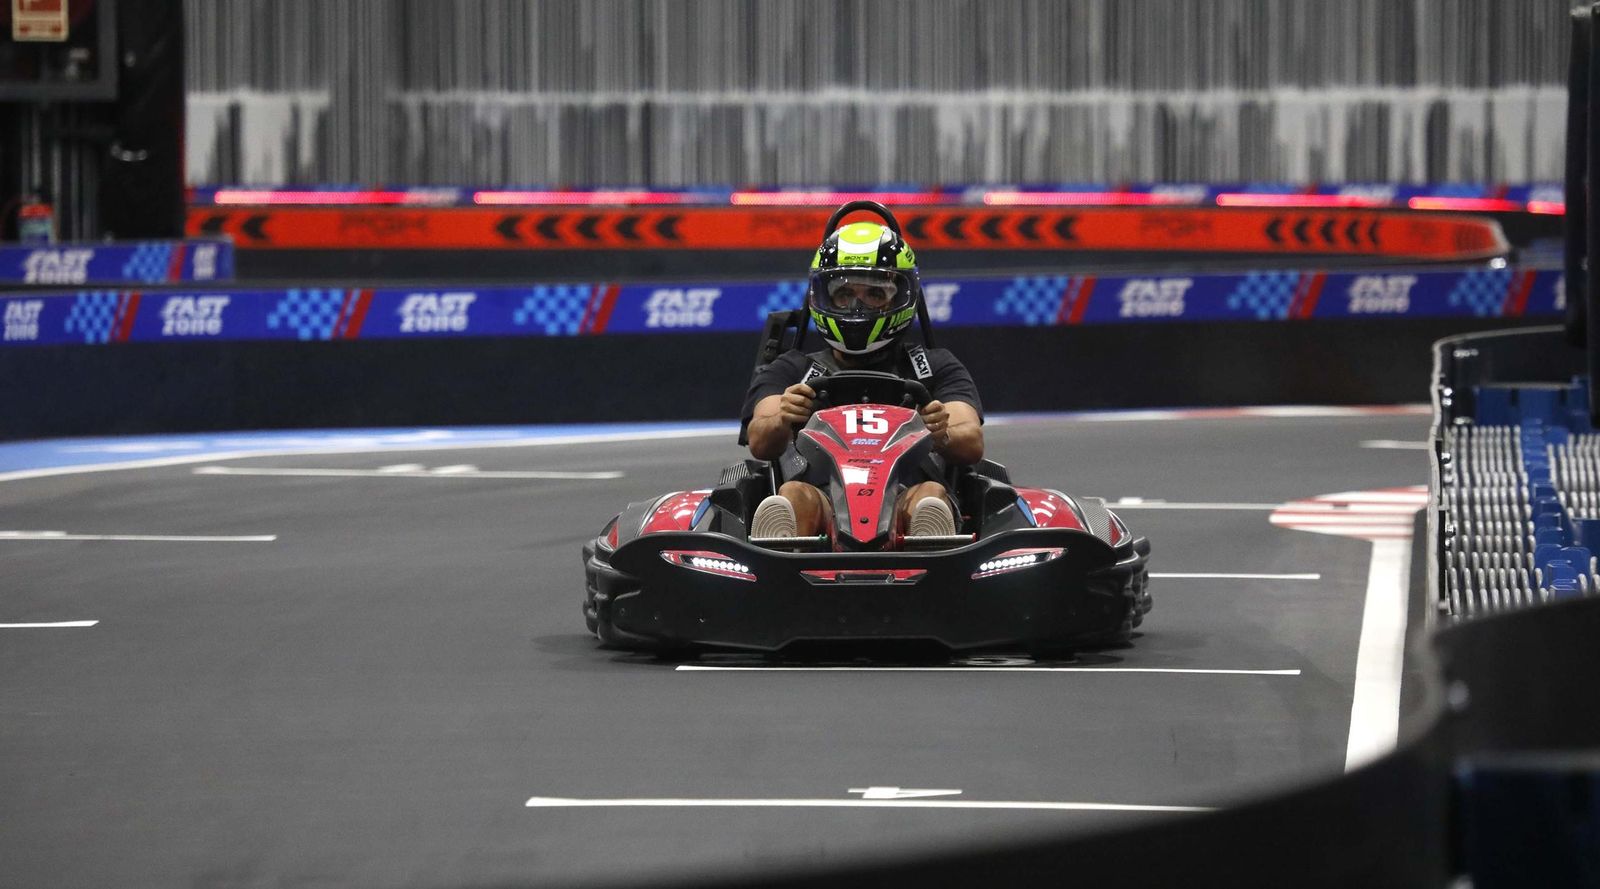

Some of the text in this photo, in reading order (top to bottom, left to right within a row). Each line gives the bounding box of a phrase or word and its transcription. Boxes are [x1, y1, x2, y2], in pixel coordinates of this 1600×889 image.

[160, 295, 231, 319] FAST
[398, 293, 476, 316] FAST
[643, 289, 722, 312] FAST
[842, 410, 889, 434] 15
